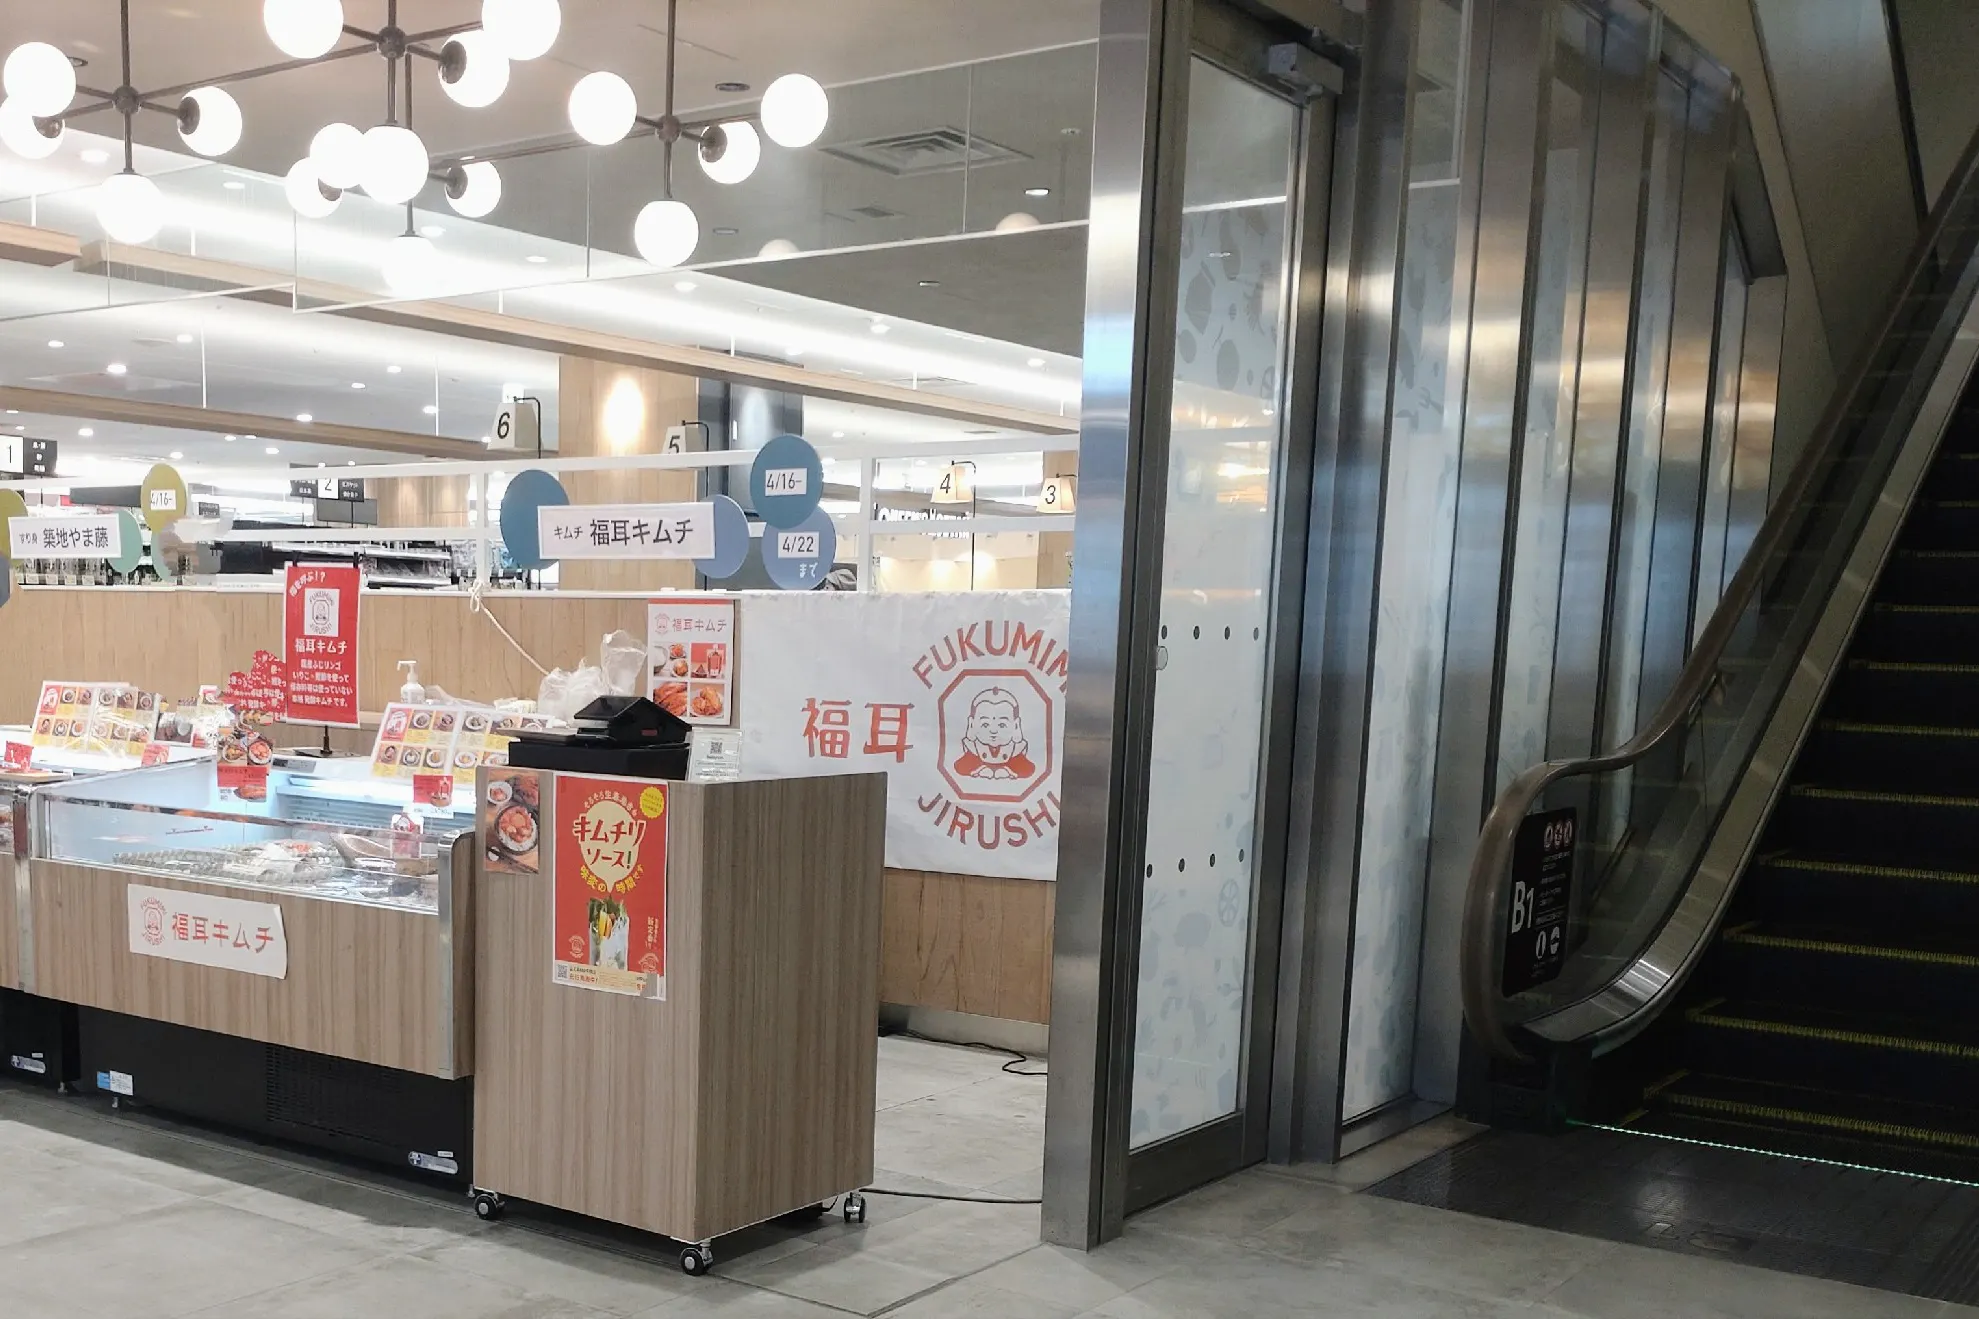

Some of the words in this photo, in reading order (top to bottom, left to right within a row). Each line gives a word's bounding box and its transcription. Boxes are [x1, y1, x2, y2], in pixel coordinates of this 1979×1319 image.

[497, 412, 511, 439] 6
[669, 435, 681, 454] 5
[939, 473, 950, 494] 4
[1045, 485, 1056, 505] 3
[19, 533, 38, 545] すり身
[43, 527, 109, 549] 築地やま藤
[553, 525, 583, 540] キムチ
[590, 518, 694, 547] 福耳キムチ
[782, 536, 814, 554] 4/22
[799, 563, 817, 578] まで
[672, 618, 727, 633] 福耳キムチ
[295, 638, 348, 655] 福耳キムチ
[801, 697, 915, 763] 福耳
[573, 814, 646, 847] キムチリ
[918, 790, 1061, 850] JIRUSHI
[587, 848, 632, 870] ソース!
[1511, 880, 1535, 934] B1
[172, 911, 274, 954] 福耳キムチ
